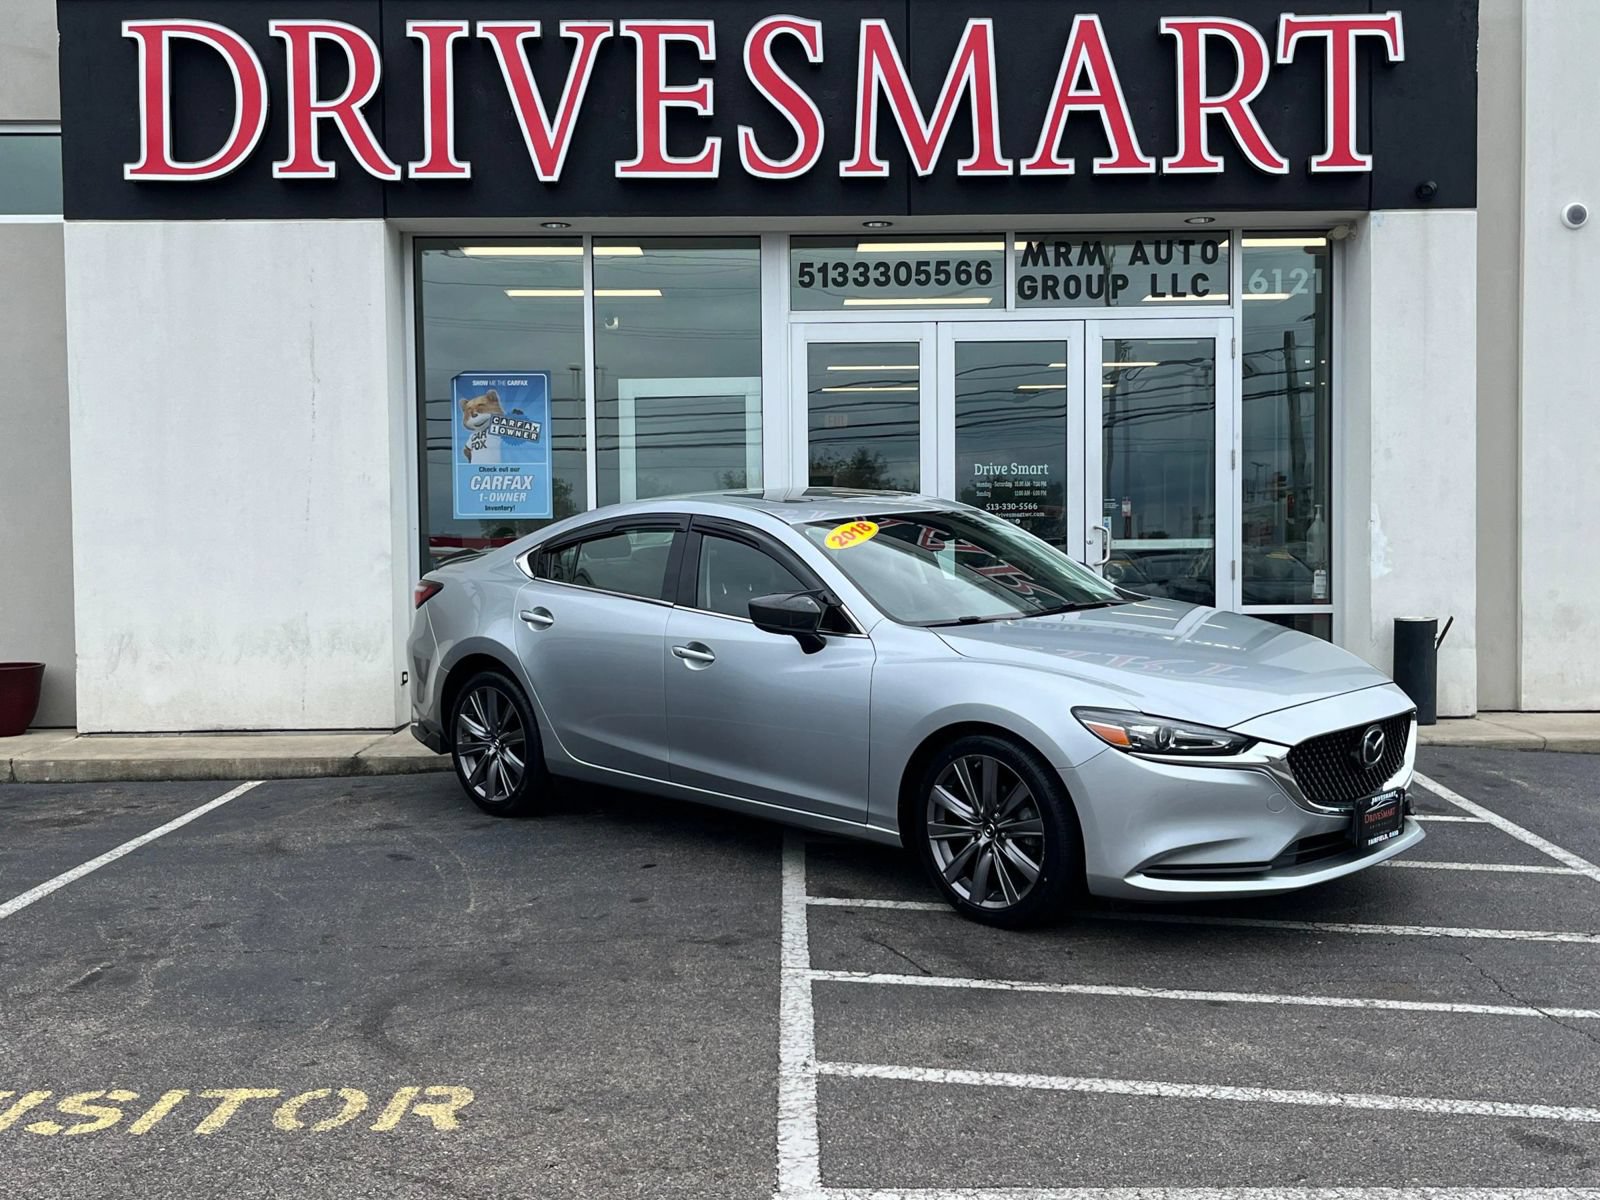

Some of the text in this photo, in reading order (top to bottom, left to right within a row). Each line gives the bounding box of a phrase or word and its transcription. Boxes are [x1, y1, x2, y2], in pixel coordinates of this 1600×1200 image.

[121, 11, 1405, 183] DRIVESMART
[1020, 240, 1219, 267] MRM AUTO
[798, 260, 993, 289] 5133305566
[1247, 268, 1323, 294] 6121
[1017, 273, 1210, 300] GROUP LLC
[493, 417, 540, 432] CARFAX
[499, 428, 538, 440] OWNER
[974, 463, 1049, 475] Drive Smart
[470, 475, 533, 490] CARFAX
[479, 492, 527, 502] 1-OWNER
[986, 503, 1038, 511] 513-330-5566
[831, 521, 872, 546] 2018
